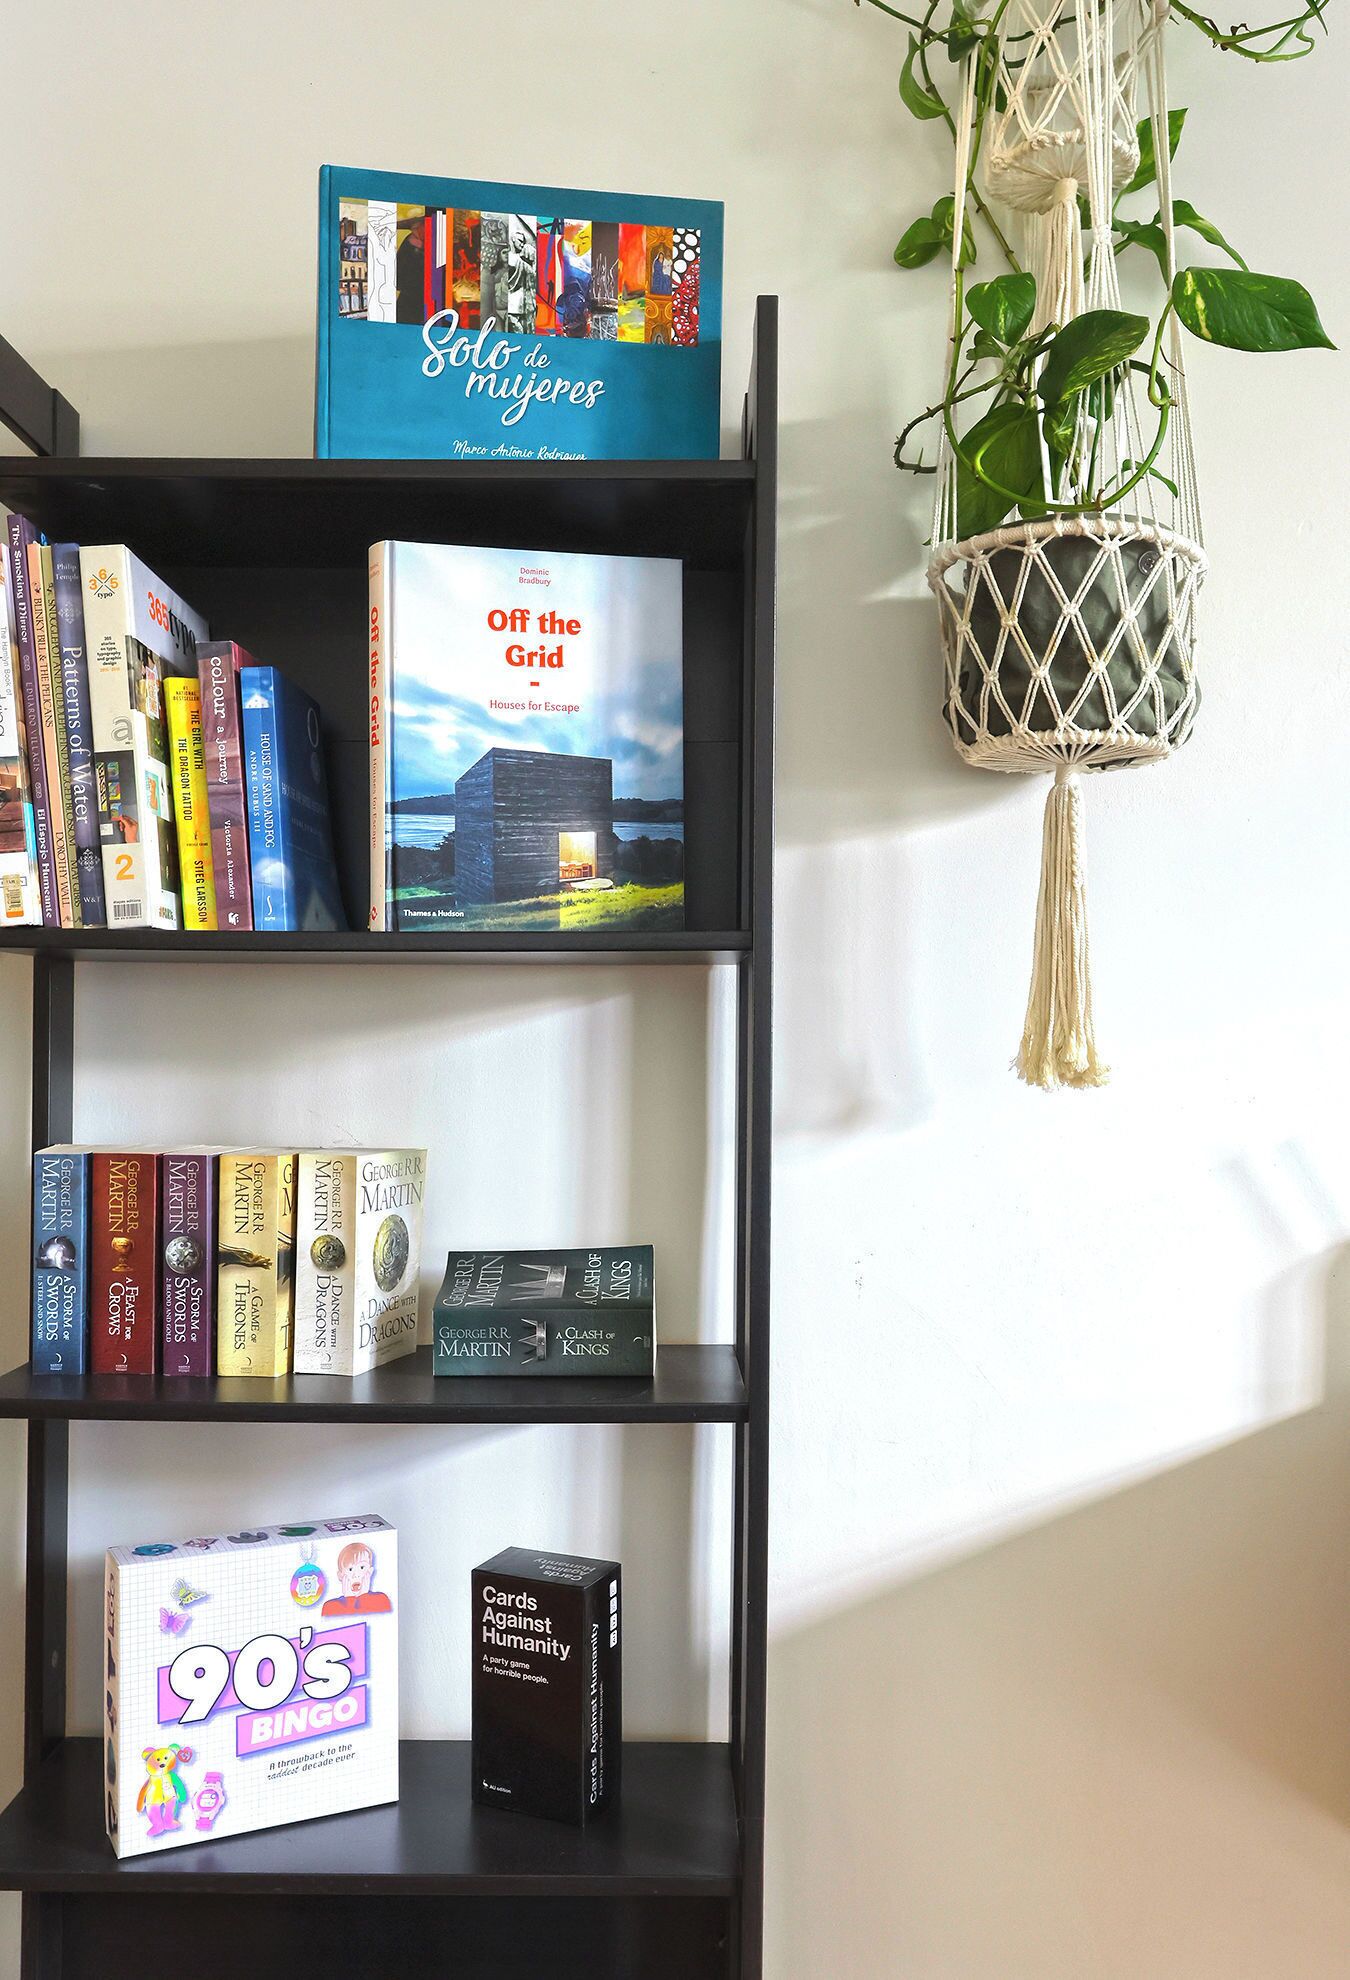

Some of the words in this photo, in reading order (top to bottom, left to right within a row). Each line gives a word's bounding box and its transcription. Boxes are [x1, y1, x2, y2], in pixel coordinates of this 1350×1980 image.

[422, 309, 521, 377] Solo
[524, 343, 550, 368] de
[465, 372, 605, 426] mujeres
[453, 439, 488, 458] Marco
[491, 442, 533, 458] Antonio
[12, 525, 20, 546] The
[14, 550, 24, 599] Smoking
[518, 577, 551, 587] Bradbury
[520, 567, 550, 576] Dominic
[97, 592, 113, 600] typo
[19, 602, 28, 643] Mirror
[34, 598, 44, 632] BLINKY
[370, 606, 379, 642] Off
[487, 608, 530, 632] Off
[537, 610, 581, 635] the
[37, 633, 47, 652] BILL
[39, 653, 47, 661] &
[505, 644, 564, 668] Grid
[40, 663, 49, 681] THE
[370, 649, 380, 689] the
[26, 682, 36, 727] EDUARDO
[63, 646, 82, 729] Patterns
[210, 656, 226, 719] colour
[41, 682, 54, 728] PELICANS
[191, 709, 200, 725] THE
[370, 695, 380, 747] Grid
[490, 699, 526, 710] Houses
[528, 700, 541, 711] for
[544, 701, 580, 714] Escape
[70, 734, 91, 757] of
[178, 738, 187, 753] THE
[192, 727, 202, 747] GIRL
[216, 725, 225, 734] a
[194, 749, 204, 770] WITH
[215, 737, 228, 784] journey
[260, 733, 272, 766] HOUSE
[179, 756, 190, 789] DRAGON
[262, 767, 272, 781] OF
[71, 761, 92, 824] Water
[182, 792, 193, 821] TATTOO
[252, 786, 260, 817] DUBUS
[262, 782, 272, 807] SAND
[38, 808, 46, 820] El
[263, 809, 274, 829] AND
[38, 823, 49, 860] Espejo
[224, 818, 232, 856] Victoria
[265, 829, 275, 848] FOG
[56, 832, 69, 879] DOROTHY
[71, 860, 80, 882] MAY
[115, 854, 135, 881] 2
[194, 860, 205, 884] STIEG
[42, 863, 52, 918] Humeante
[61, 881, 71, 907] WALL
[227, 859, 236, 900] Alexander
[196, 886, 208, 923] LARSSON
[403, 909, 431, 918] Thames
[438, 910, 464, 918] Hudson
[60, 1158, 74, 1207] GEORGE
[127, 1160, 140, 1208] GEORGE
[186, 1160, 200, 1209] GEORGE
[252, 1162, 266, 1210] GEORGE
[331, 1160, 344, 1208] GEORGE
[362, 1162, 403, 1183] GEORGE
[42, 1158, 60, 1231] MARTIN
[109, 1160, 127, 1233] MARTIN
[168, 1160, 187, 1234] MARTIN
[234, 1161, 253, 1234] MARTIN
[314, 1160, 332, 1232] MARTIN
[360, 1180, 423, 1214] MARTIN
[442, 1278, 471, 1306] GEORGE
[464, 1255, 505, 1307] MARTIN
[575, 1269, 601, 1299] CLASH
[588, 1253, 602, 1268] OF
[601, 1260, 632, 1300] KINGS
[46, 1275, 63, 1341] SWORDS
[63, 1285, 76, 1328] STORM
[108, 1282, 125, 1335] CROWS
[125, 1286, 139, 1325] FEAST
[174, 1277, 190, 1343] SWORDS
[190, 1287, 203, 1330] STORM
[234, 1279, 251, 1350] THRONES
[250, 1295, 263, 1332] GAME
[315, 1274, 331, 1348] DRAGONS
[331, 1284, 343, 1326] DANCE
[360, 1311, 366, 1322] A
[368, 1294, 400, 1320] DANCE
[401, 1295, 417, 1307] WITH
[62, 1330, 70, 1340] OF
[190, 1332, 197, 1342] OF
[250, 1333, 257, 1343] OF
[359, 1312, 416, 1349] DRAGONS
[438, 1326, 487, 1339] GEORGE
[564, 1326, 603, 1339] CLASH
[438, 1339, 512, 1357] MARTIN
[562, 1340, 610, 1356] KINGS
[534, 1558, 596, 1573] Humanity
[539, 1564, 590, 1576] Against
[543, 1570, 583, 1581] Cards
[482, 1585, 538, 1611] Cards
[482, 1606, 552, 1634] Against
[482, 1625, 571, 1661] Humanity
[590, 1623, 599, 1696] Humanity
[168, 1626, 352, 1725] 90's
[482, 1664, 493, 1673] for
[494, 1666, 521, 1679] horrible
[522, 1673, 549, 1684] people.
[489, 1656, 509, 1667] party
[510, 1660, 530, 1670] game
[250, 1696, 358, 1745] BINGO
[590, 1696, 599, 1753] Against
[269, 1762, 276, 1771] A
[277, 1750, 325, 1769] throwback
[327, 1747, 336, 1756] to
[338, 1743, 353, 1753] the
[302, 1758, 334, 1772] decade
[335, 1752, 356, 1763] ever
[590, 1757, 598, 1804] Cards
